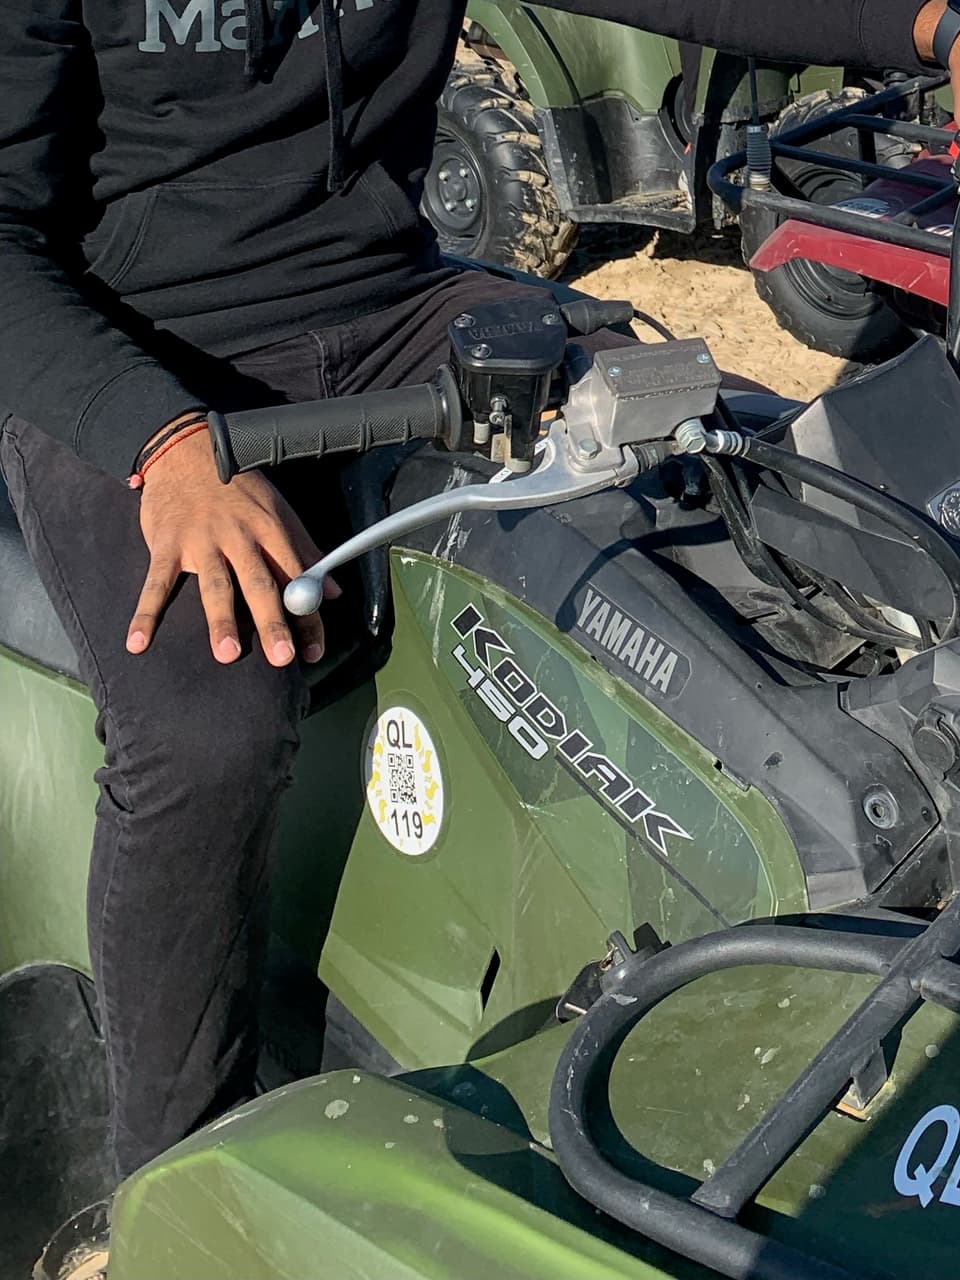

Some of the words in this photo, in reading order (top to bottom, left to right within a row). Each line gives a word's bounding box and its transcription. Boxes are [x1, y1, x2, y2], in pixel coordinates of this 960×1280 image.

[575, 588, 679, 694] YAMAHA
[386, 719, 413, 749] QL
[450, 602, 694, 857] KODIAK
[452, 644, 550, 760] 450
[391, 809, 423, 839] 119
